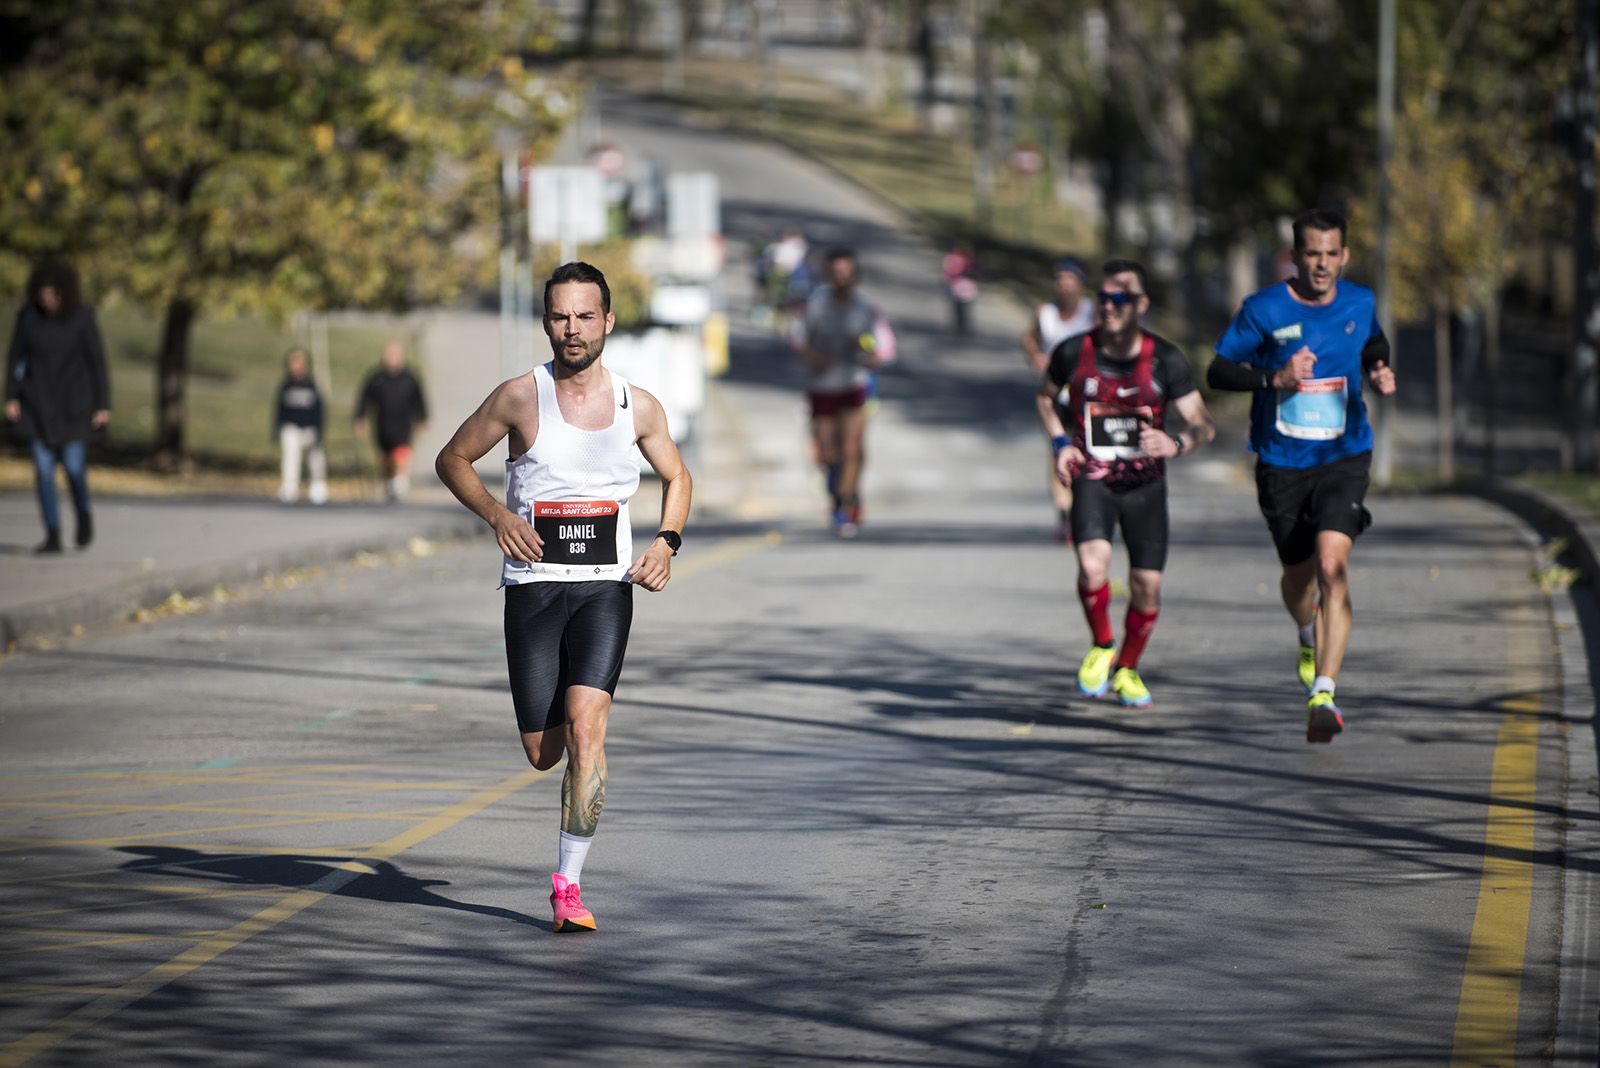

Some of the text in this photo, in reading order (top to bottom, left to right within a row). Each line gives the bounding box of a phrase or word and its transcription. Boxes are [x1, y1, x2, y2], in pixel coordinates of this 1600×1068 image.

[541, 507, 561, 515] MITJA
[559, 524, 596, 539] DANIEL
[569, 542, 586, 554] 836
